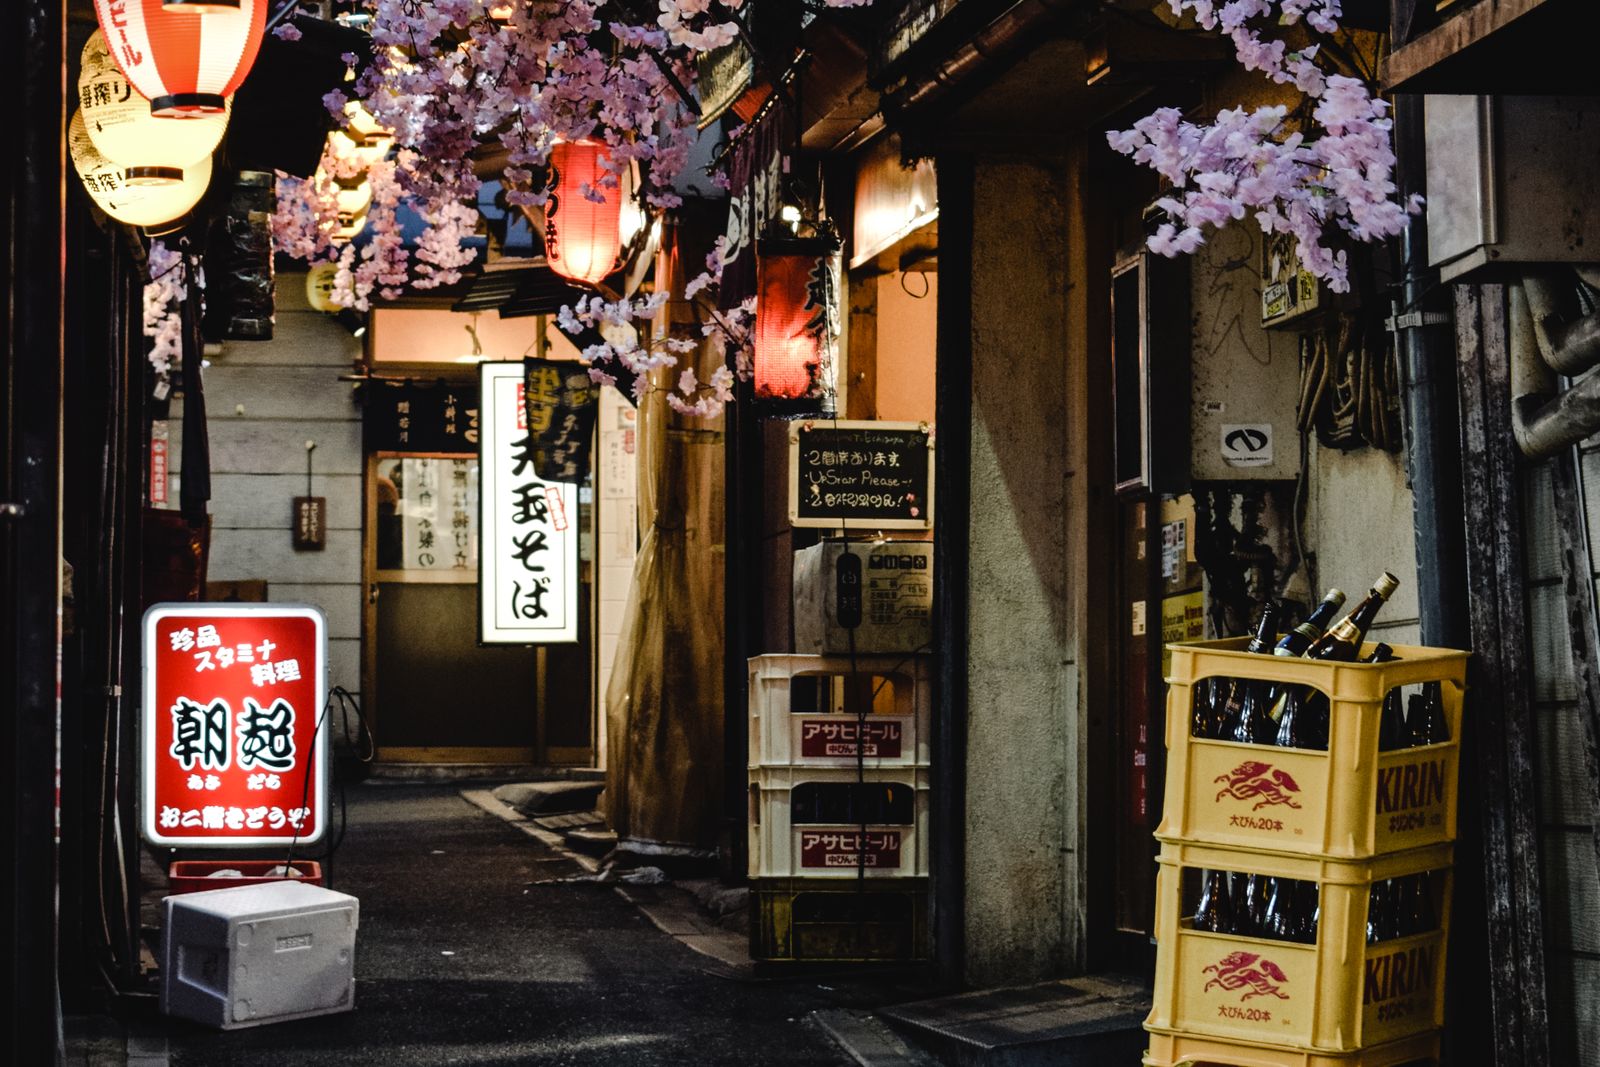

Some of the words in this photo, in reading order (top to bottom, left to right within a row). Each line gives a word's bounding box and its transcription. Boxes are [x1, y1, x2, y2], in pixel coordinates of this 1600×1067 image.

[170, 625, 221, 651] 珍品
[194, 639, 276, 672] スタミナ
[250, 659, 301, 686] 料理
[804, 723, 899, 741] アサヒビール
[1376, 759, 1445, 815] KIRIN
[1229, 814, 1284, 832] 大びん20本
[803, 834, 898, 851] アサヒビール
[1363, 943, 1434, 1005] KIRIN
[1217, 1005, 1271, 1023] 大びん20本
